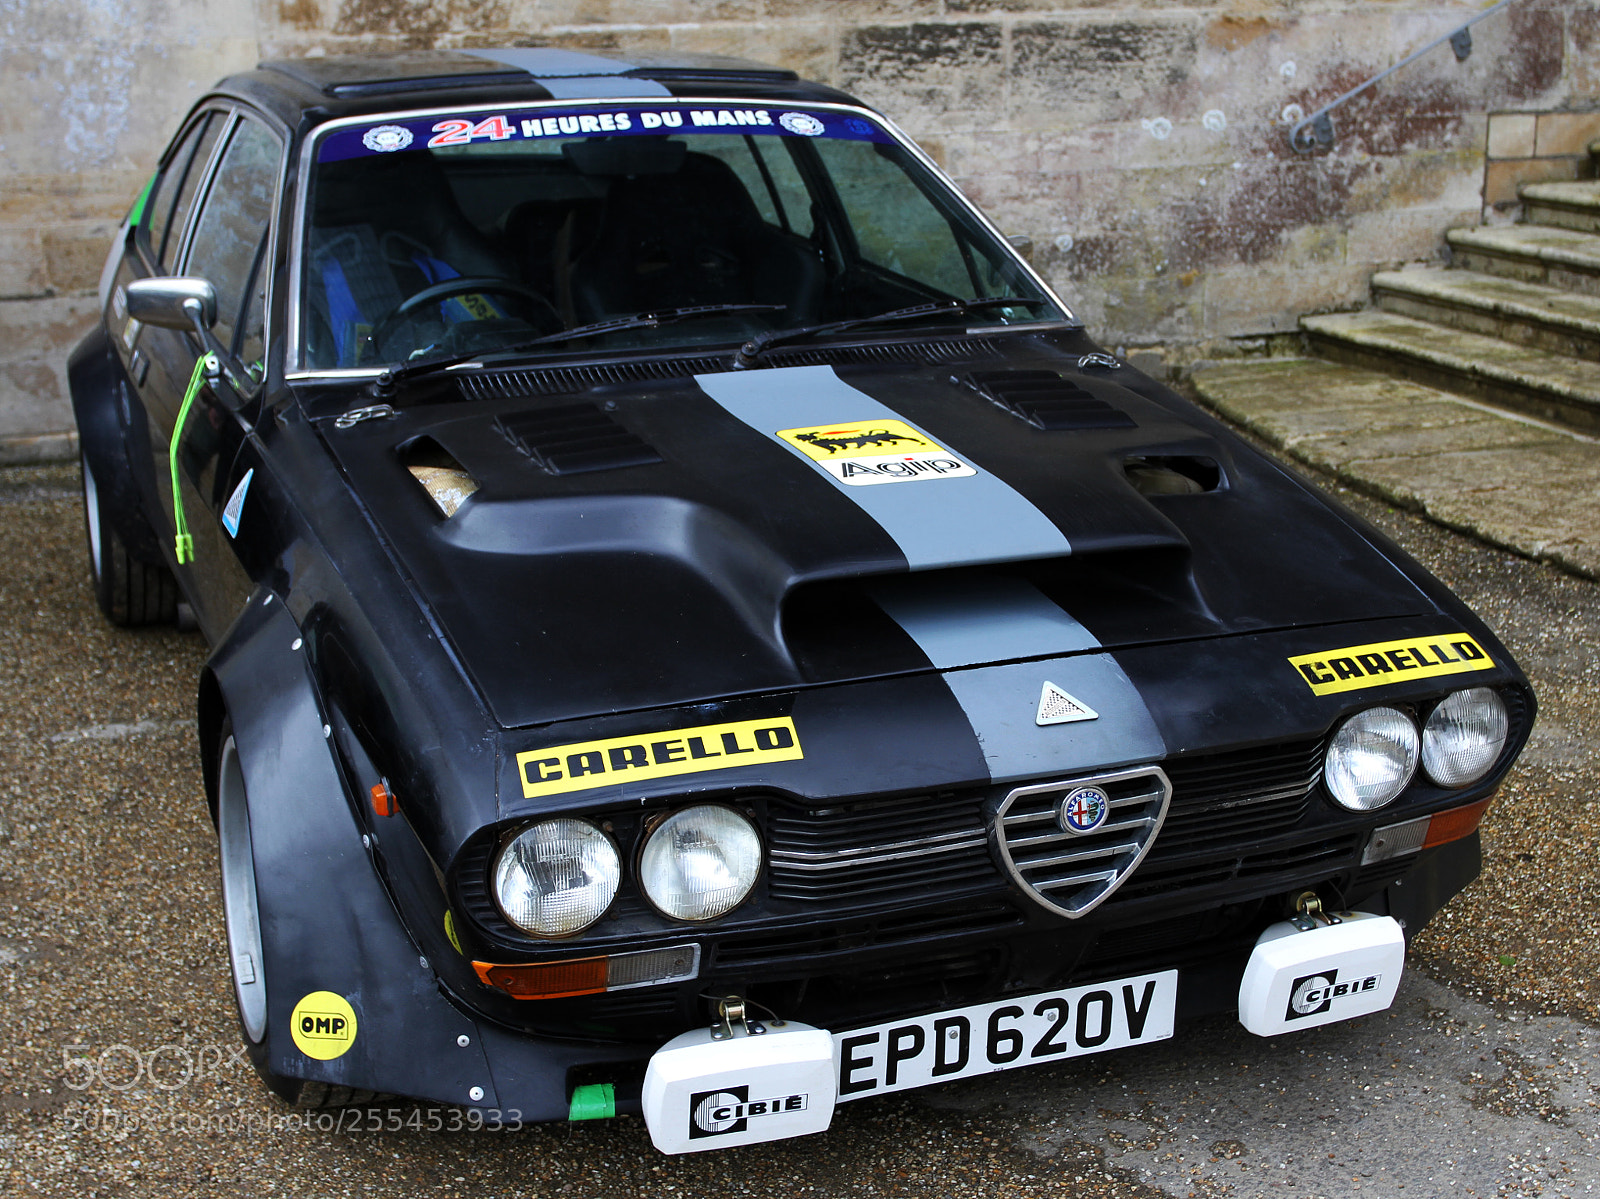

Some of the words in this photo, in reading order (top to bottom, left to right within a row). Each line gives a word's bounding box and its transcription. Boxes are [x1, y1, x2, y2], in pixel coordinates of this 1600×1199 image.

[427, 115, 517, 149] 24
[520, 112, 632, 138] HEURES
[640, 111, 684, 129] DU
[690, 110, 772, 127] MANS
[841, 457, 962, 479] Agip
[1298, 641, 1486, 685] CARELLO
[524, 726, 795, 785] CARELLO
[301, 1016, 346, 1035] OMP
[839, 1015, 970, 1096] EPD
[985, 980, 1157, 1065] 620V
